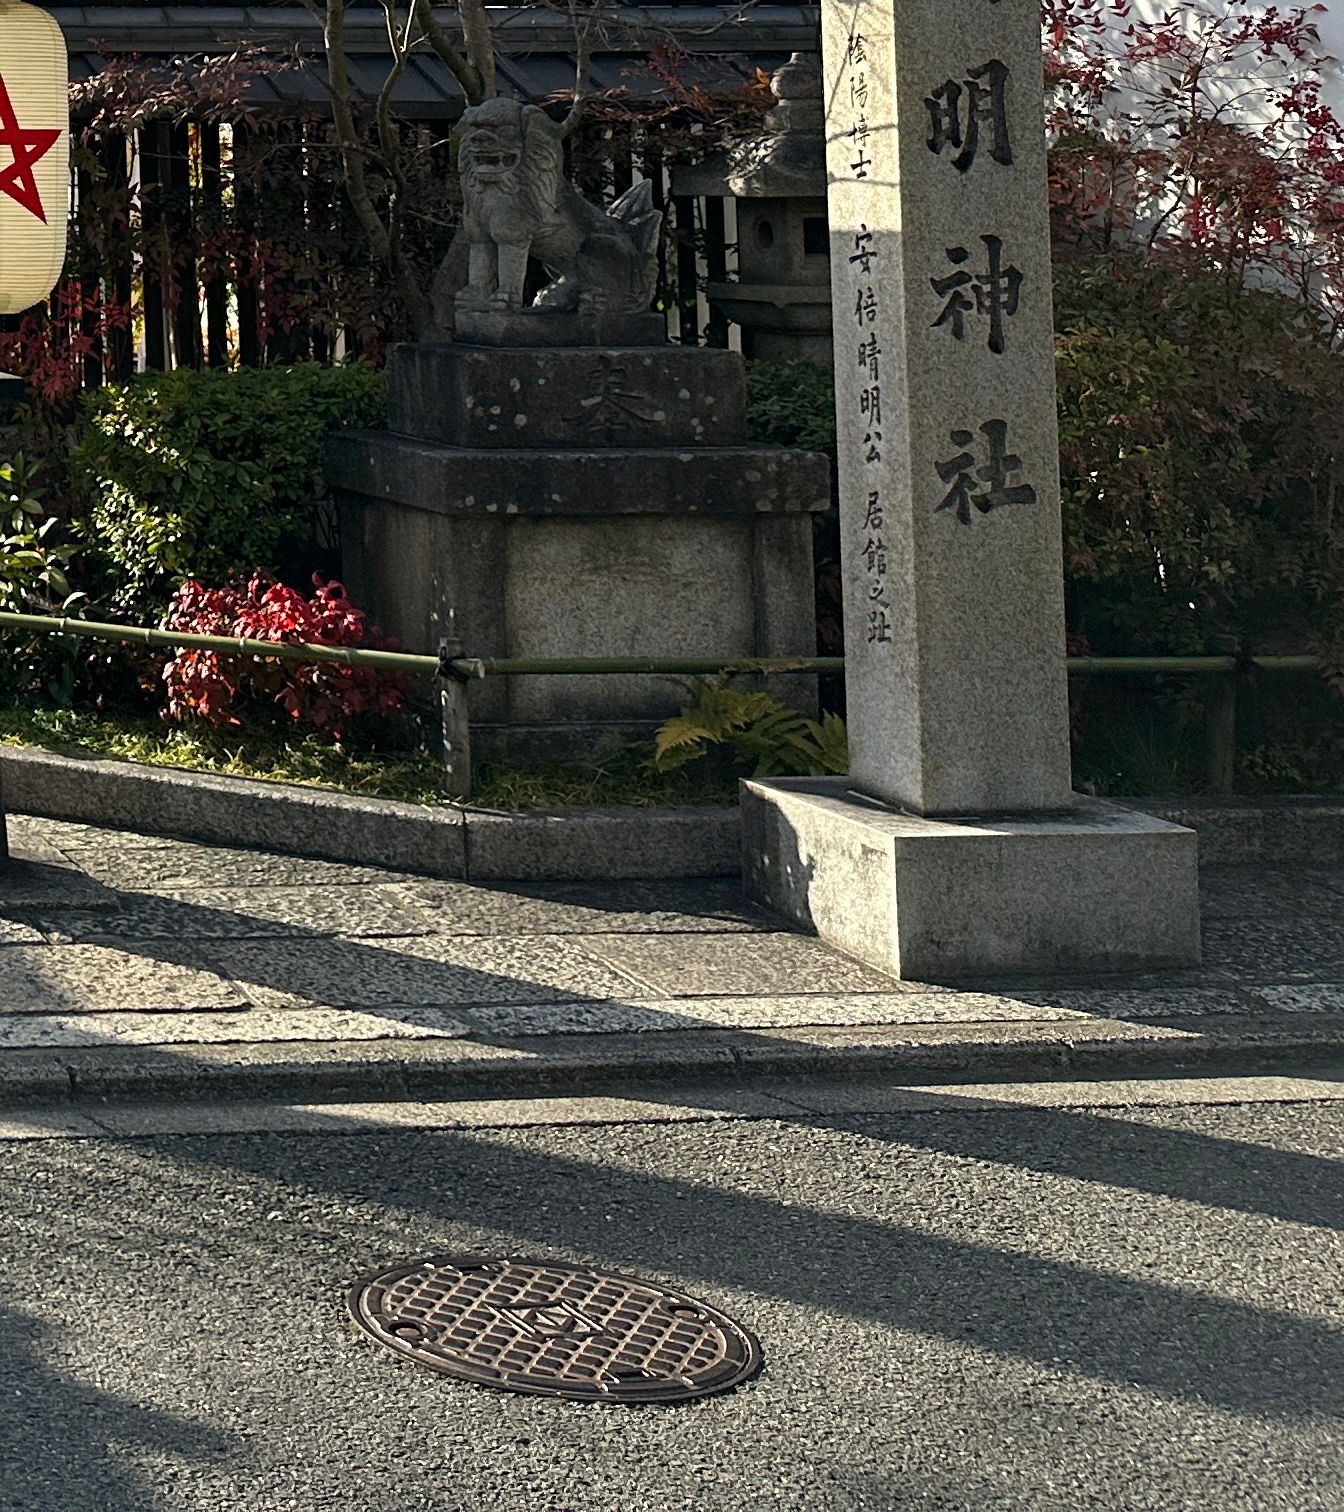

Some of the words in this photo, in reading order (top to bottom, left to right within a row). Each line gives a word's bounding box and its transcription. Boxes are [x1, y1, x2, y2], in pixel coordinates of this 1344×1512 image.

[847, 33, 873, 179] 陰陽博士
[560, 353, 662, 442] 奉
[848, 224, 883, 464] 安倍晴明公
